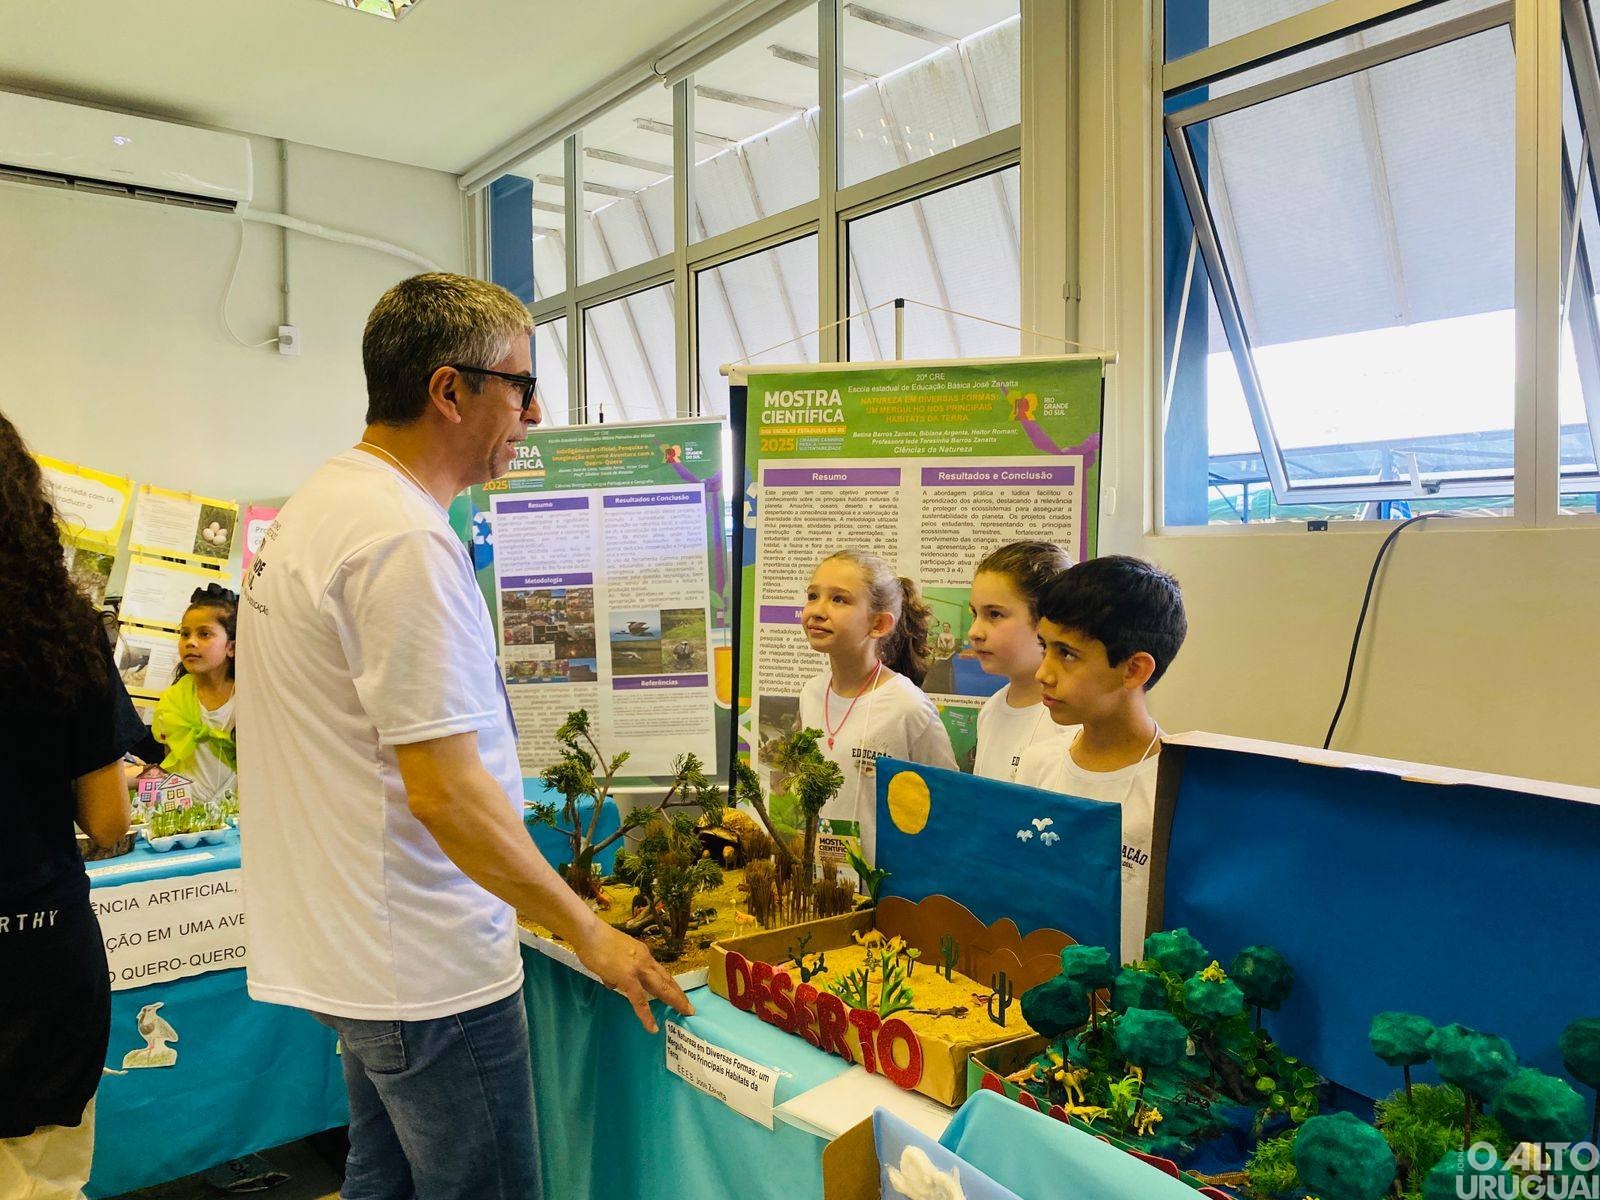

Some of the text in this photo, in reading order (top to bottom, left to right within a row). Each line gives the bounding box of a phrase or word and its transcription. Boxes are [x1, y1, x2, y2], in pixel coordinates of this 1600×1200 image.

[872, 384, 900, 392] estadual
[912, 383, 945, 391] Educação
[947, 381, 971, 389] Básica
[991, 380, 1019, 388] Zanatta
[764, 389, 842, 408] MOSTRA
[761, 406, 844, 424] CIENTÍFICA
[761, 438, 795, 452] 2025
[894, 446, 925, 454] Ciências
[812, 472, 847, 480] Resumo
[938, 472, 990, 480] Resultados
[1001, 471, 1053, 480] Conclusão
[63, 487, 87, 496] criada
[482, 479, 509, 492] 2025
[527, 501, 553, 509] Resumo
[615, 495, 650, 504] Resultados
[656, 494, 690, 502] Conclusão
[524, 576, 563, 585] Metodologia
[640, 678, 678, 687] Referências
[852, 748, 892, 760] EDUCA
[819, 845, 848, 853] CIENTÍFIC
[91, 898, 140, 916] ÊNCIA
[0, 910, 59, 934] RTHY
[105, 912, 245, 953] ÇÃO EM UMA AVE
[121, 945, 247, 981] QUERO-QUERO
[725, 951, 923, 1090] DESERTO
[667, 1047, 679, 1060] Terra
[677, 1030, 696, 1048] Natureza
[697, 1043, 704, 1052] em
[706, 1047, 732, 1065] Diversas
[733, 1059, 758, 1076] Formas:
[759, 1073, 769, 1082] um
[668, 1035, 758, 1091] Mergulho nos Principais Habitats da
